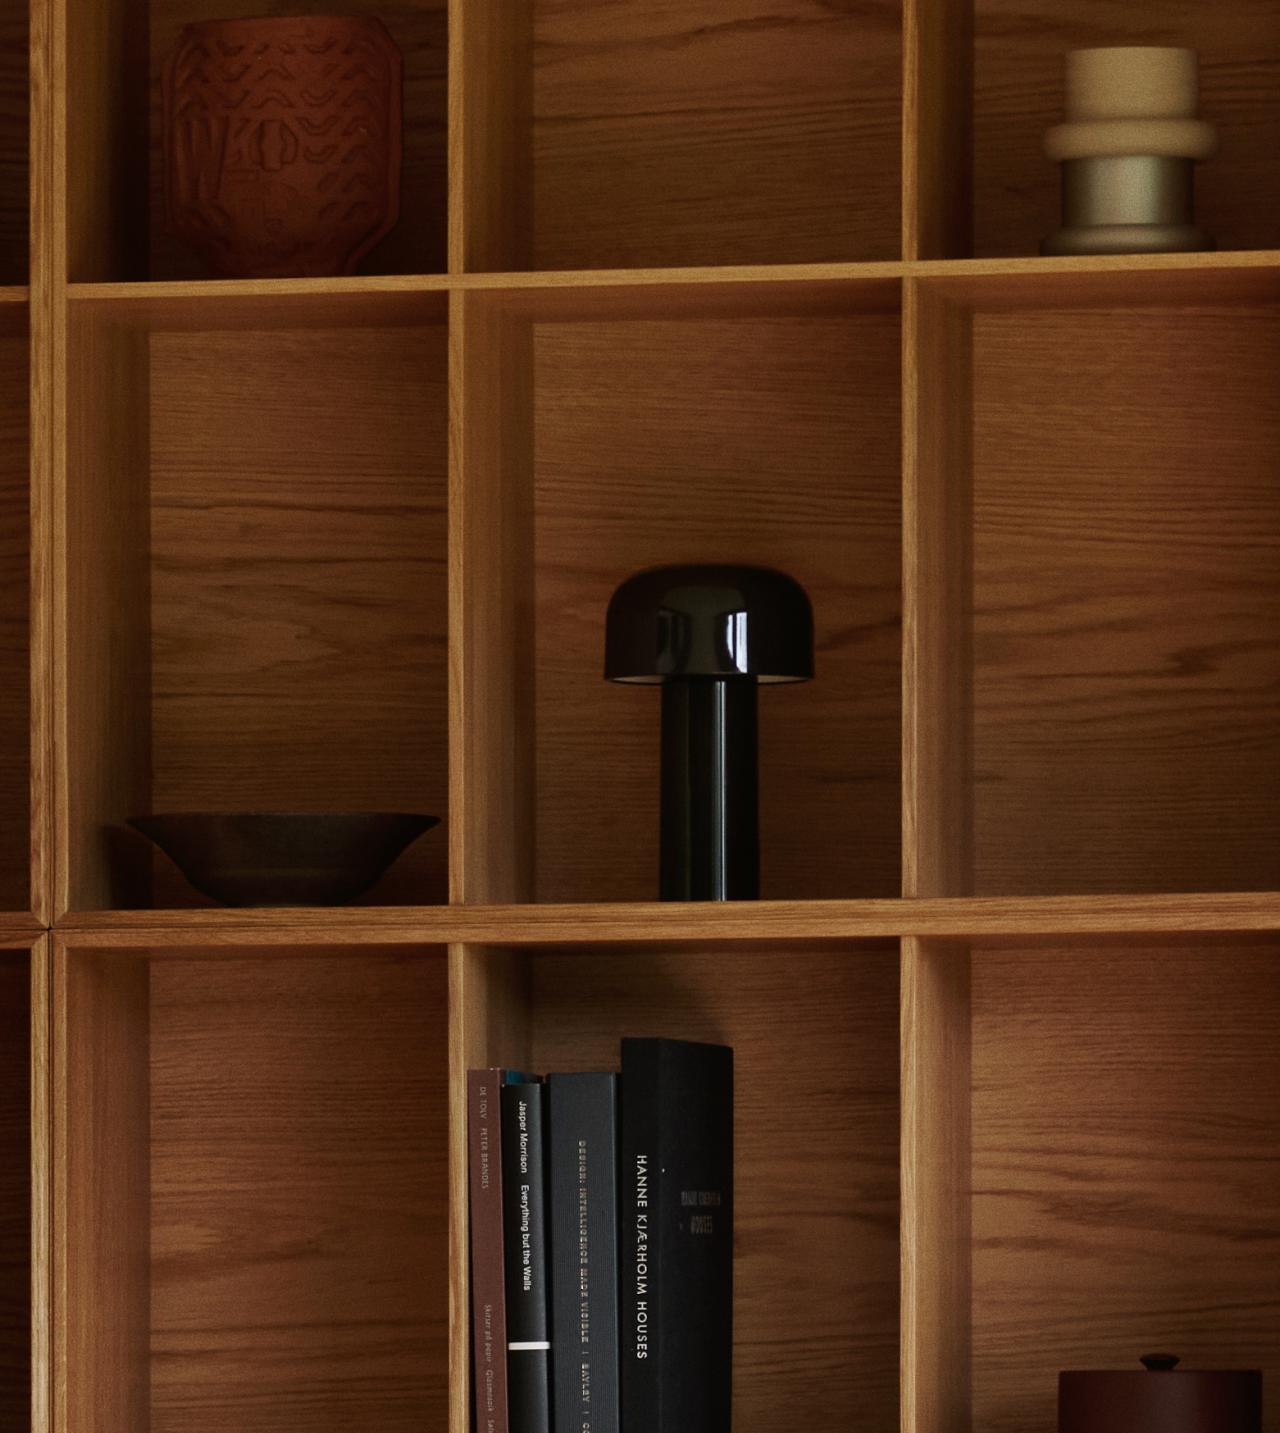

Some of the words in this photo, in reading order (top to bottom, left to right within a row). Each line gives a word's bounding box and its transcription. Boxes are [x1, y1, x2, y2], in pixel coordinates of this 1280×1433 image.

[518, 1101, 528, 1131] Jasper
[520, 1133, 528, 1173] Morrison
[579, 1140, 588, 1183] DESIGN:
[637, 1155, 648, 1207] HANNE
[520, 1185, 530, 1231] Everything
[579, 1188, 588, 1264] INTELLIGENCE
[522, 1234, 530, 1248] but
[523, 1250, 531, 1265] the
[637, 1214, 648, 1295] KJÆRHOLM
[523, 1267, 531, 1291] Walls
[580, 1268, 588, 1297] MADE
[581, 1302, 589, 1343] VISIBLE
[637, 1301, 648, 1359] HOUSES
